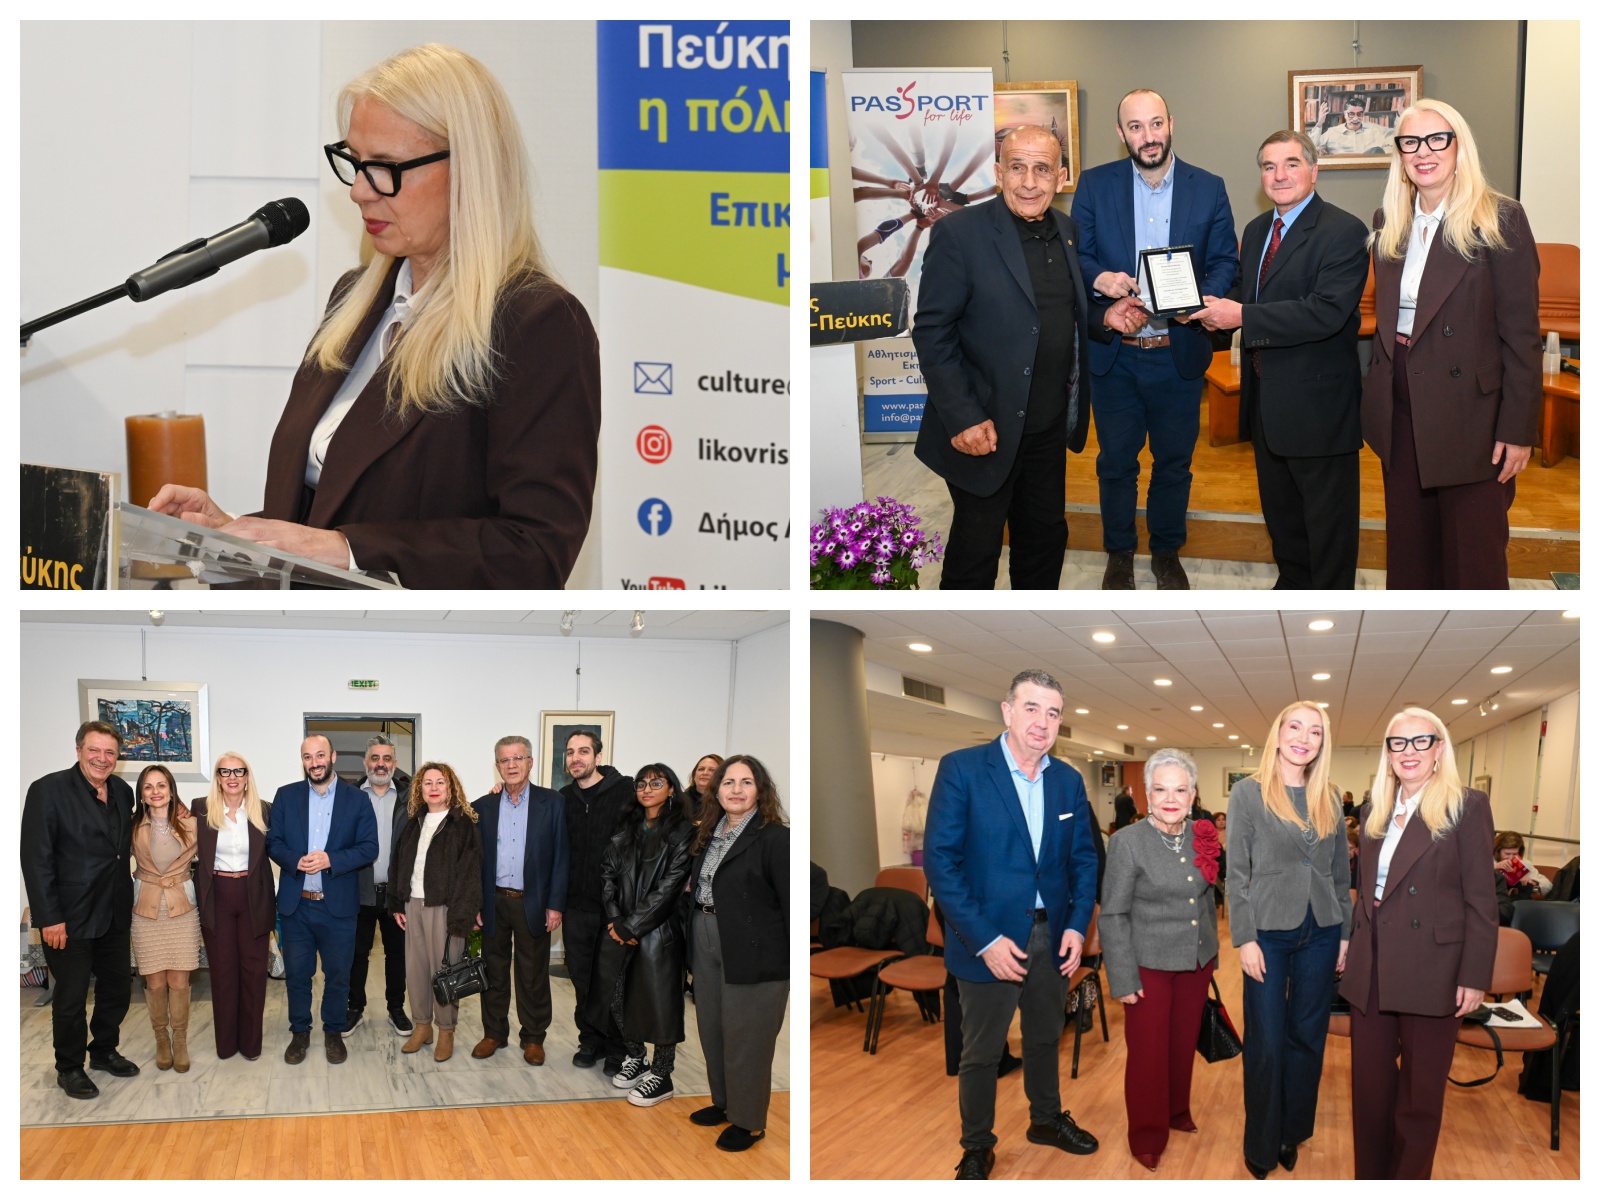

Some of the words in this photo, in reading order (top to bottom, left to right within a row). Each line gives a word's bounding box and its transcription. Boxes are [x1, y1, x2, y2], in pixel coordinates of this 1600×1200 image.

[851, 81, 989, 120] PASSPORT
[639, 98, 668, 143] η
[923, 109, 945, 126] for
[949, 109, 973, 126] life
[869, 376, 896, 389] Sport
[698, 437, 789, 465] likovris
[698, 511, 779, 542] Δήμος
[20, 546, 84, 590] ύκης
